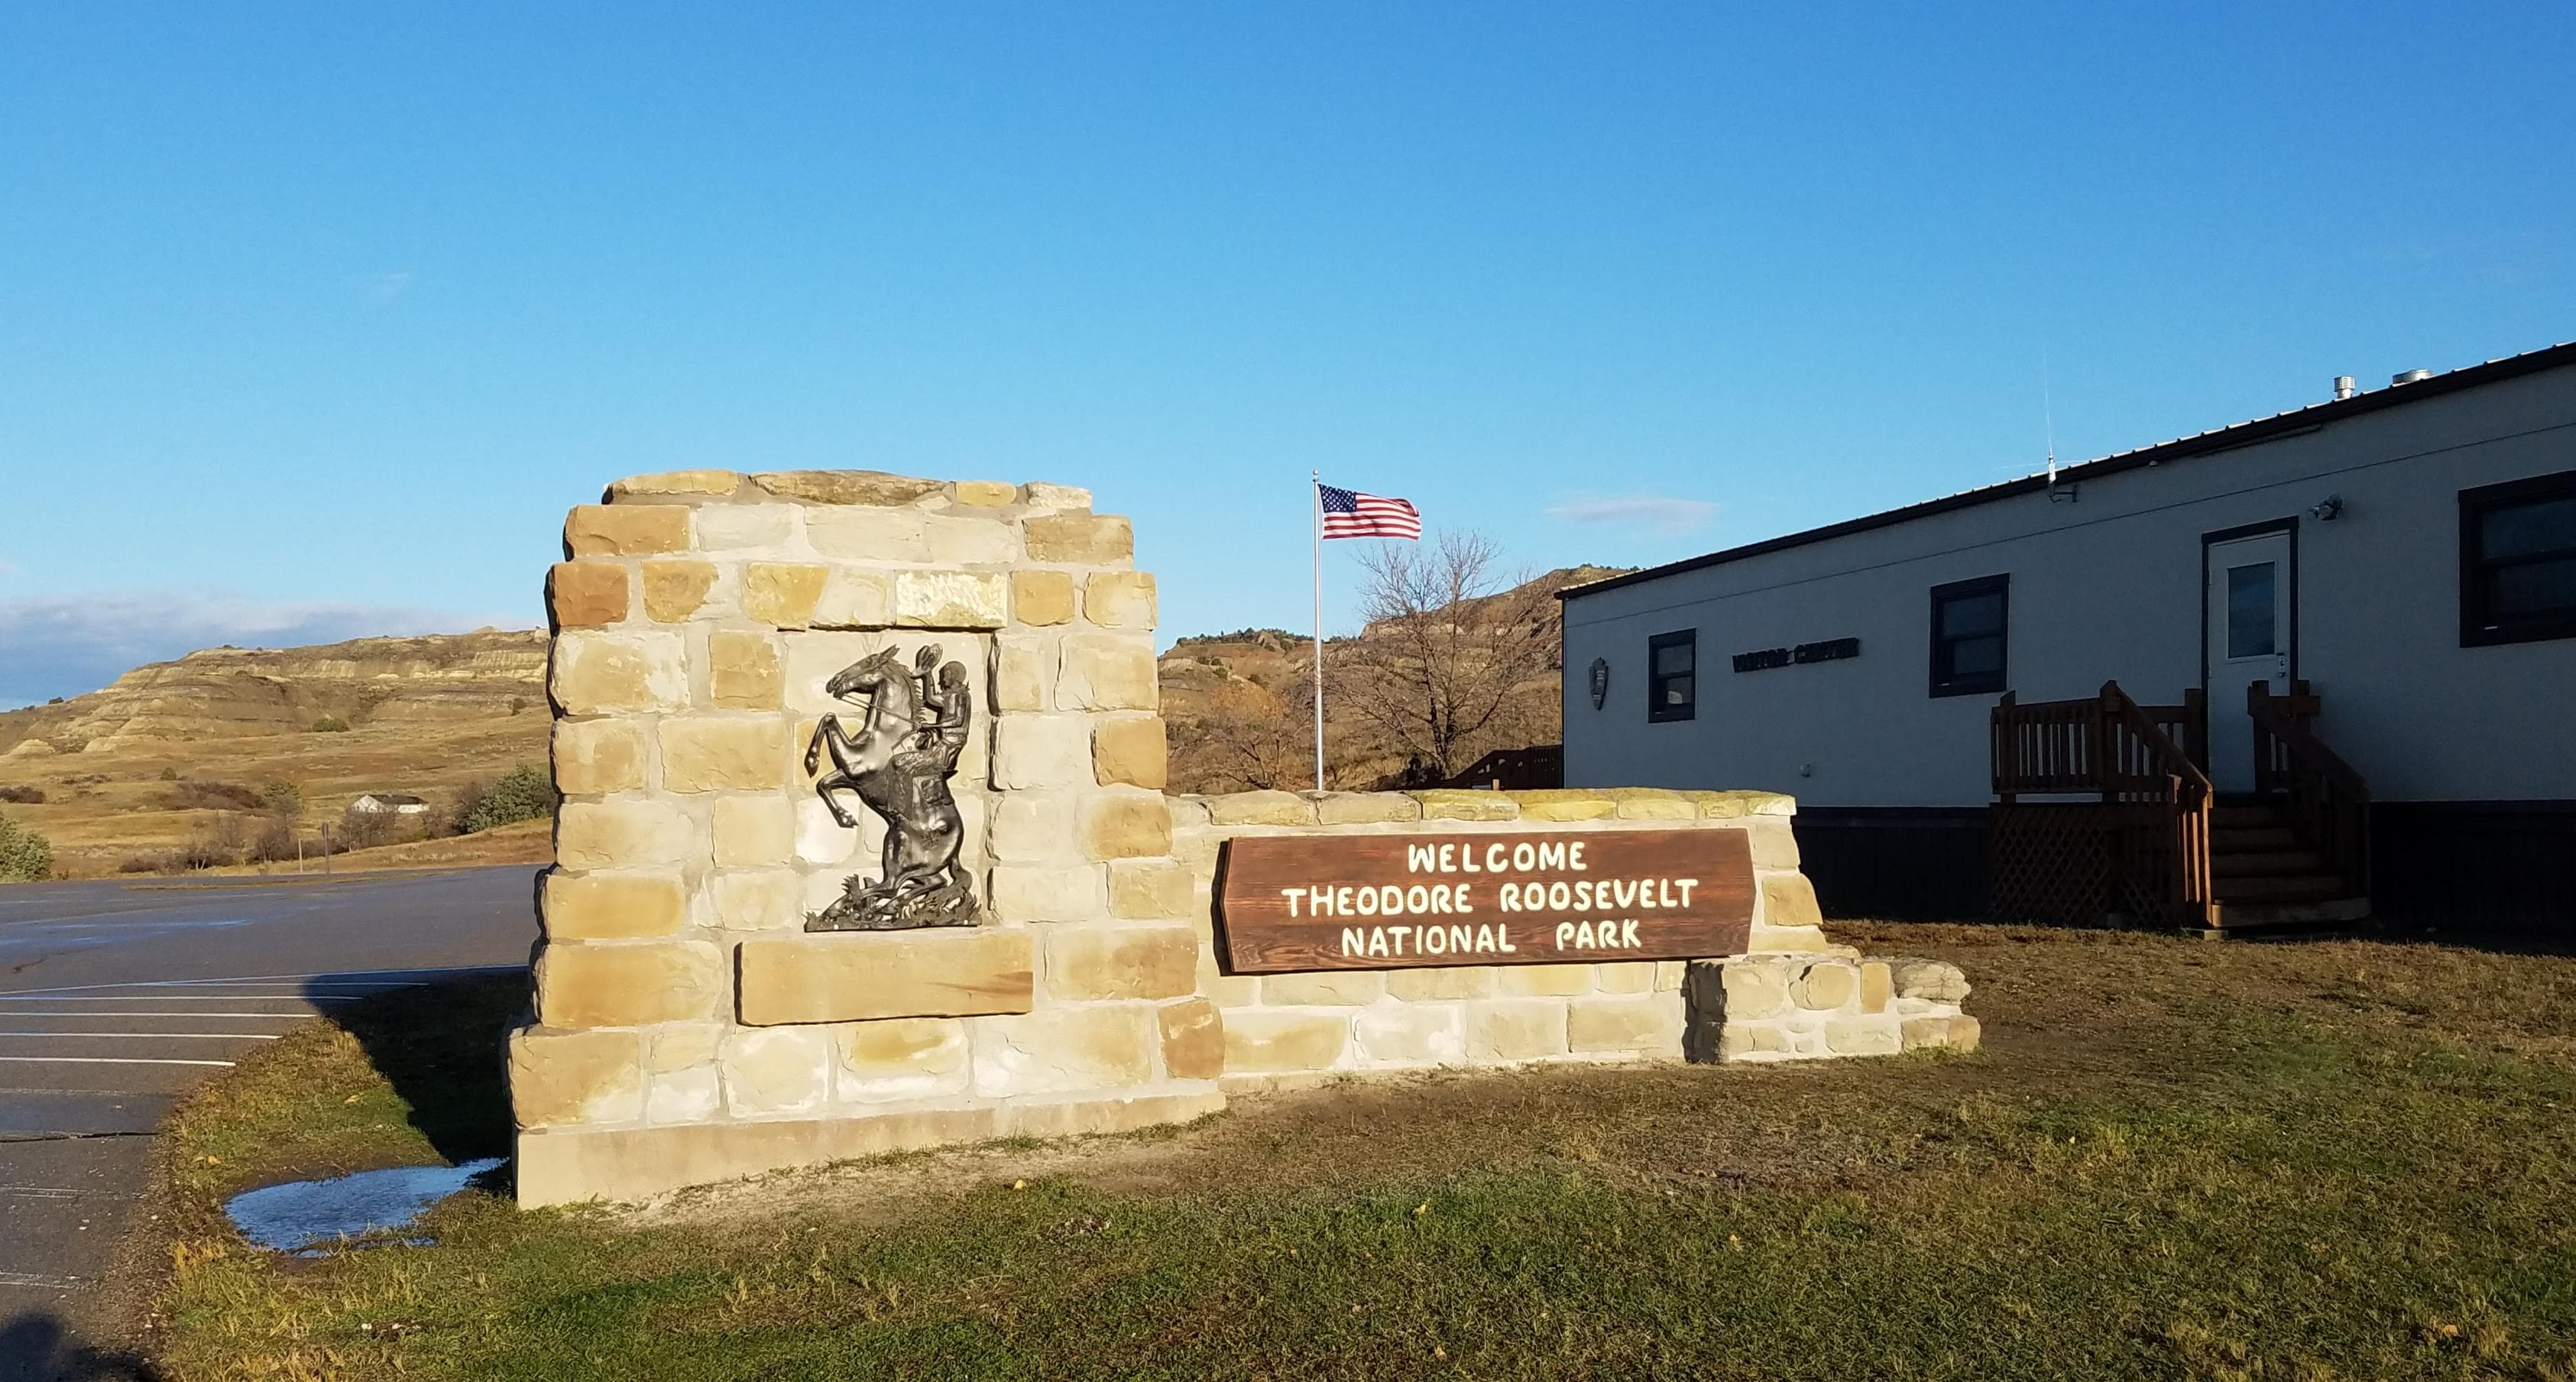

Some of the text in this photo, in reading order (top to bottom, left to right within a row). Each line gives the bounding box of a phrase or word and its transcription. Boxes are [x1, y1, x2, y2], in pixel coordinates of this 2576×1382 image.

[1408, 841, 1588, 873] WELCOME
[1281, 878, 1699, 918] THEODORE ROOSEVELT
[1341, 918, 1641, 958] NATIONAL PARK
